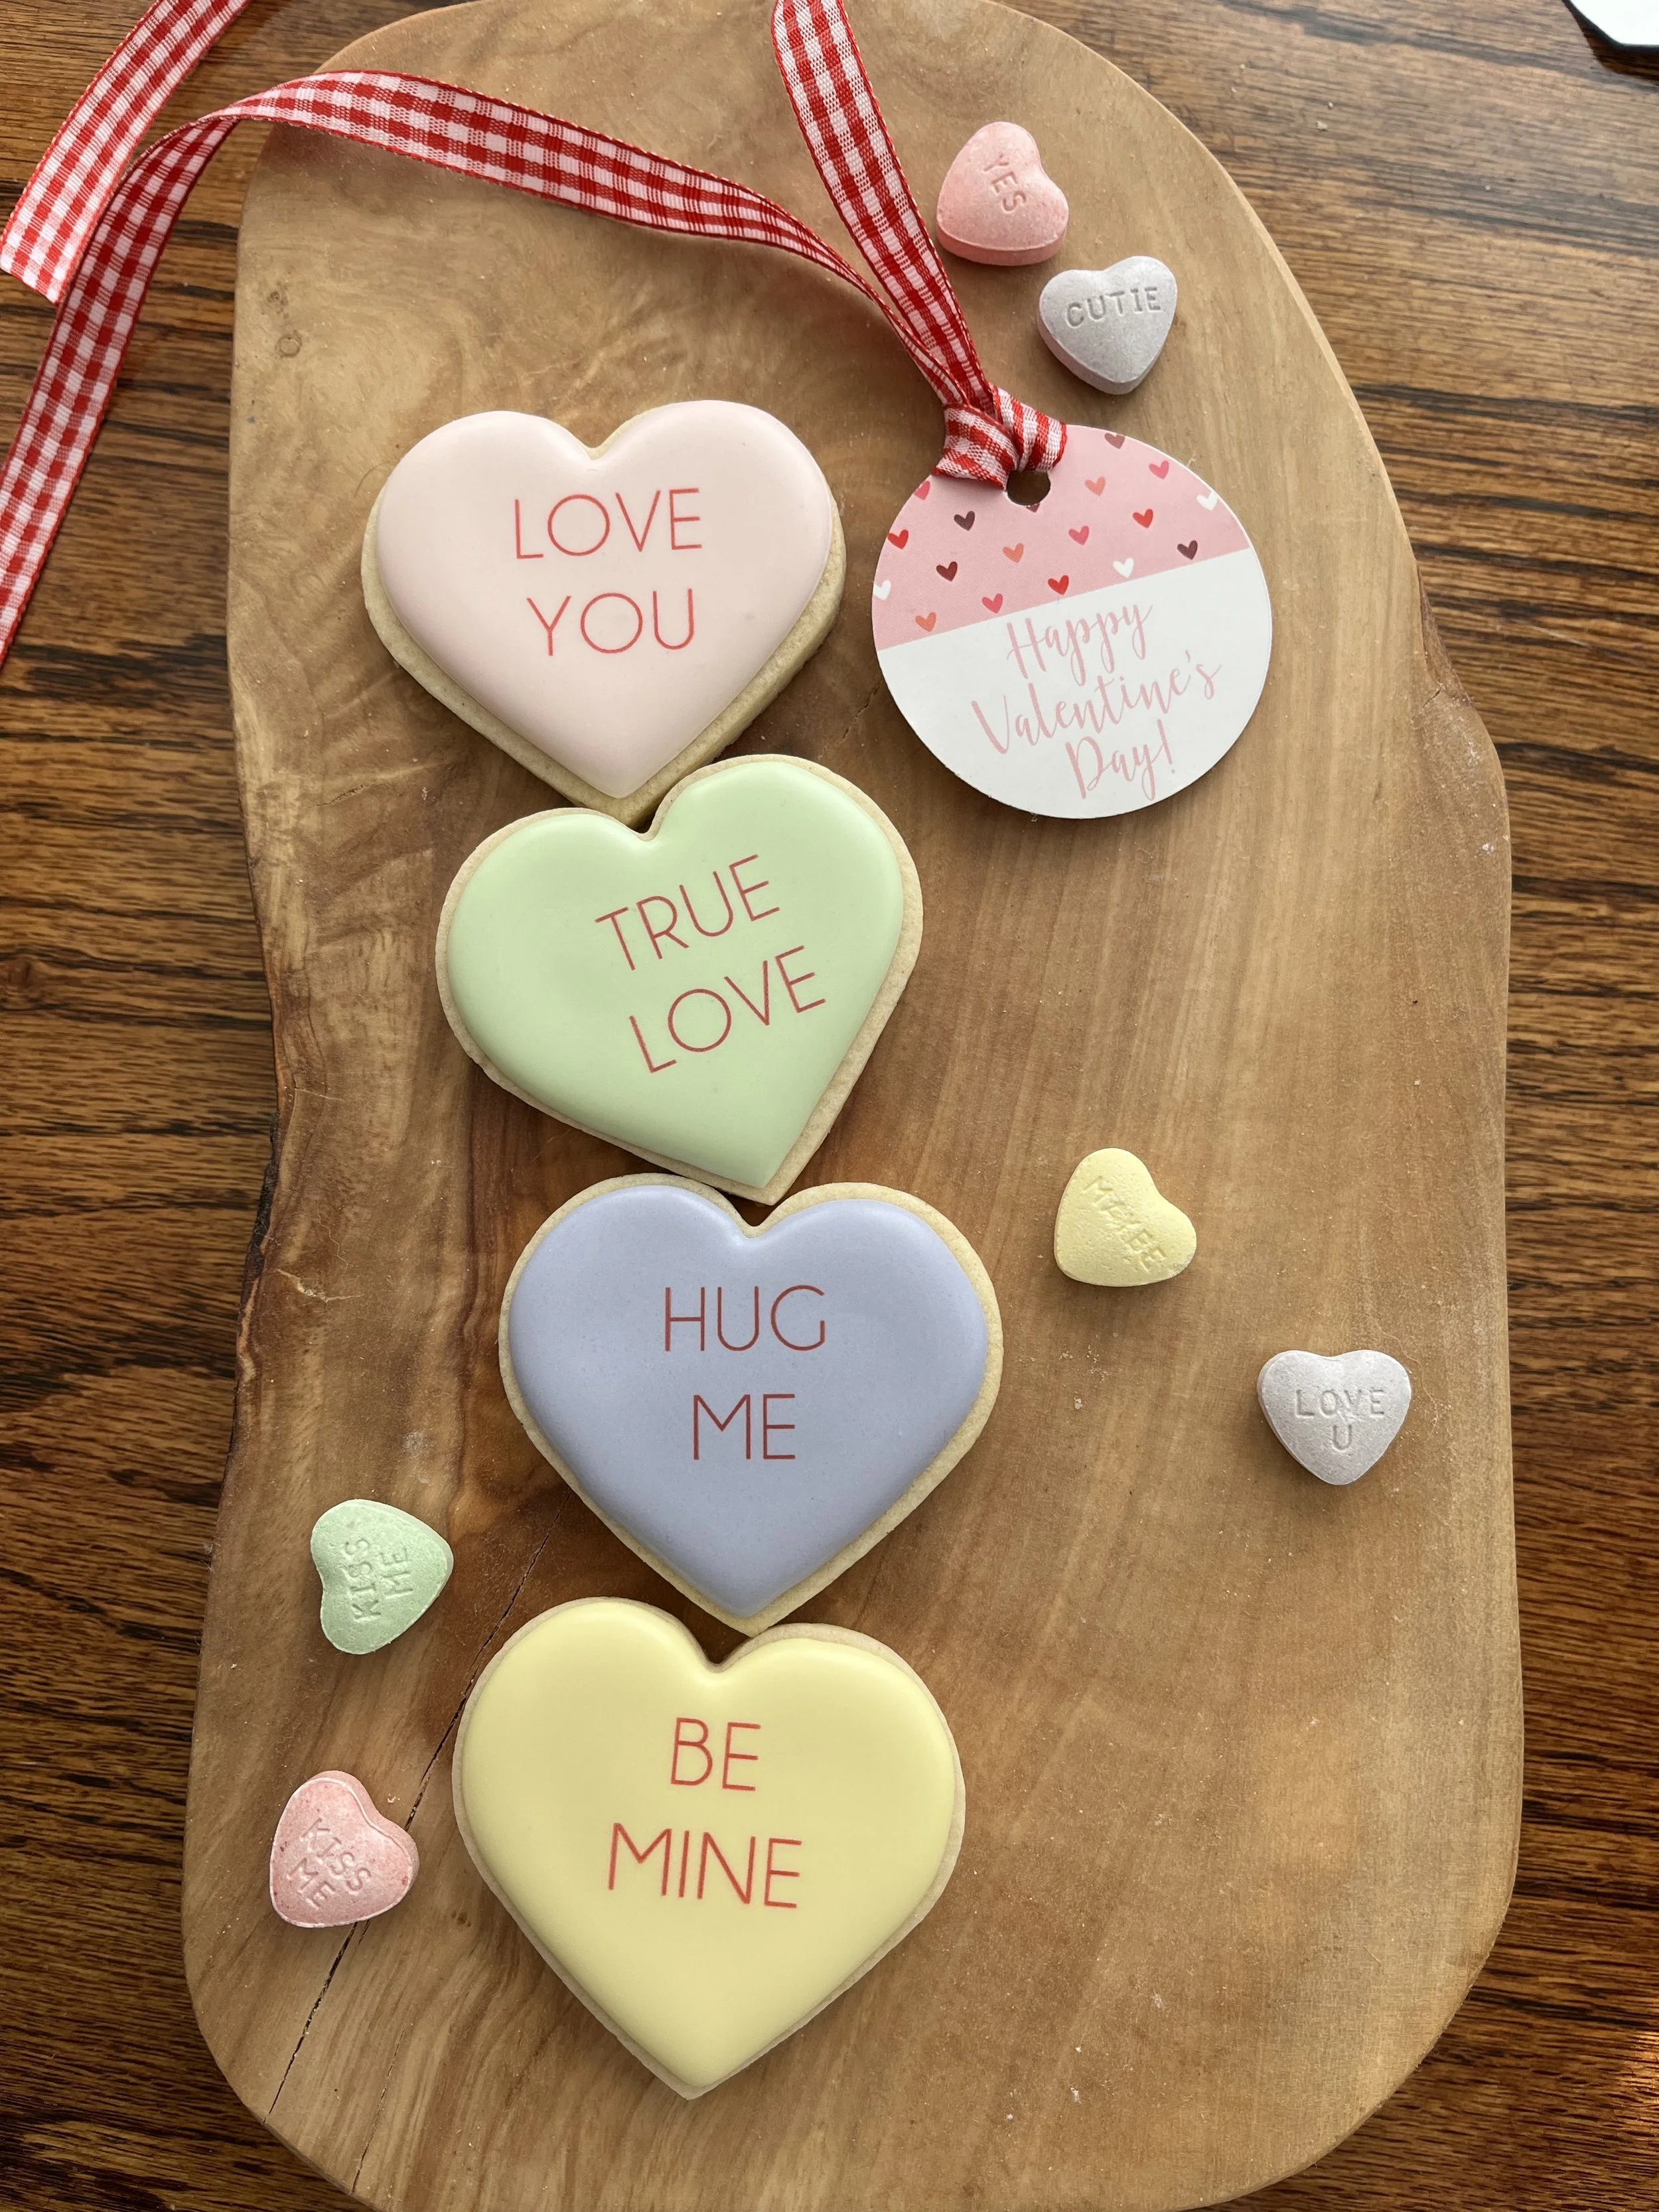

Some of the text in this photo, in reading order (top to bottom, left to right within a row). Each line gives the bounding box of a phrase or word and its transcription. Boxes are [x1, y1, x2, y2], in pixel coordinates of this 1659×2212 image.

[982, 153, 1027, 213] YES
[1065, 287, 1161, 328] CUTIE
[514, 488, 702, 559] LOVE
[527, 588, 695, 656] YOU
[1007, 604, 1153, 686] Happy
[971, 649, 1222, 755] Valentine's
[1064, 719, 1176, 801] Day!
[595, 854, 780, 970] TRUE
[629, 945, 826, 1073] LOVE
[664, 1285, 826, 1351] HUG
[693, 1394, 796, 1460] ME
[1296, 1387, 1384, 1418] LOVE
[1332, 1424, 1352, 1451] U
[343, 1538, 382, 1622] KISS
[380, 1548, 413, 1599] ME
[671, 1717, 761, 1791] BE
[287, 1858, 336, 1909] ME
[299, 1818, 372, 1894] KISS
[608, 1822, 802, 1909] MINE
